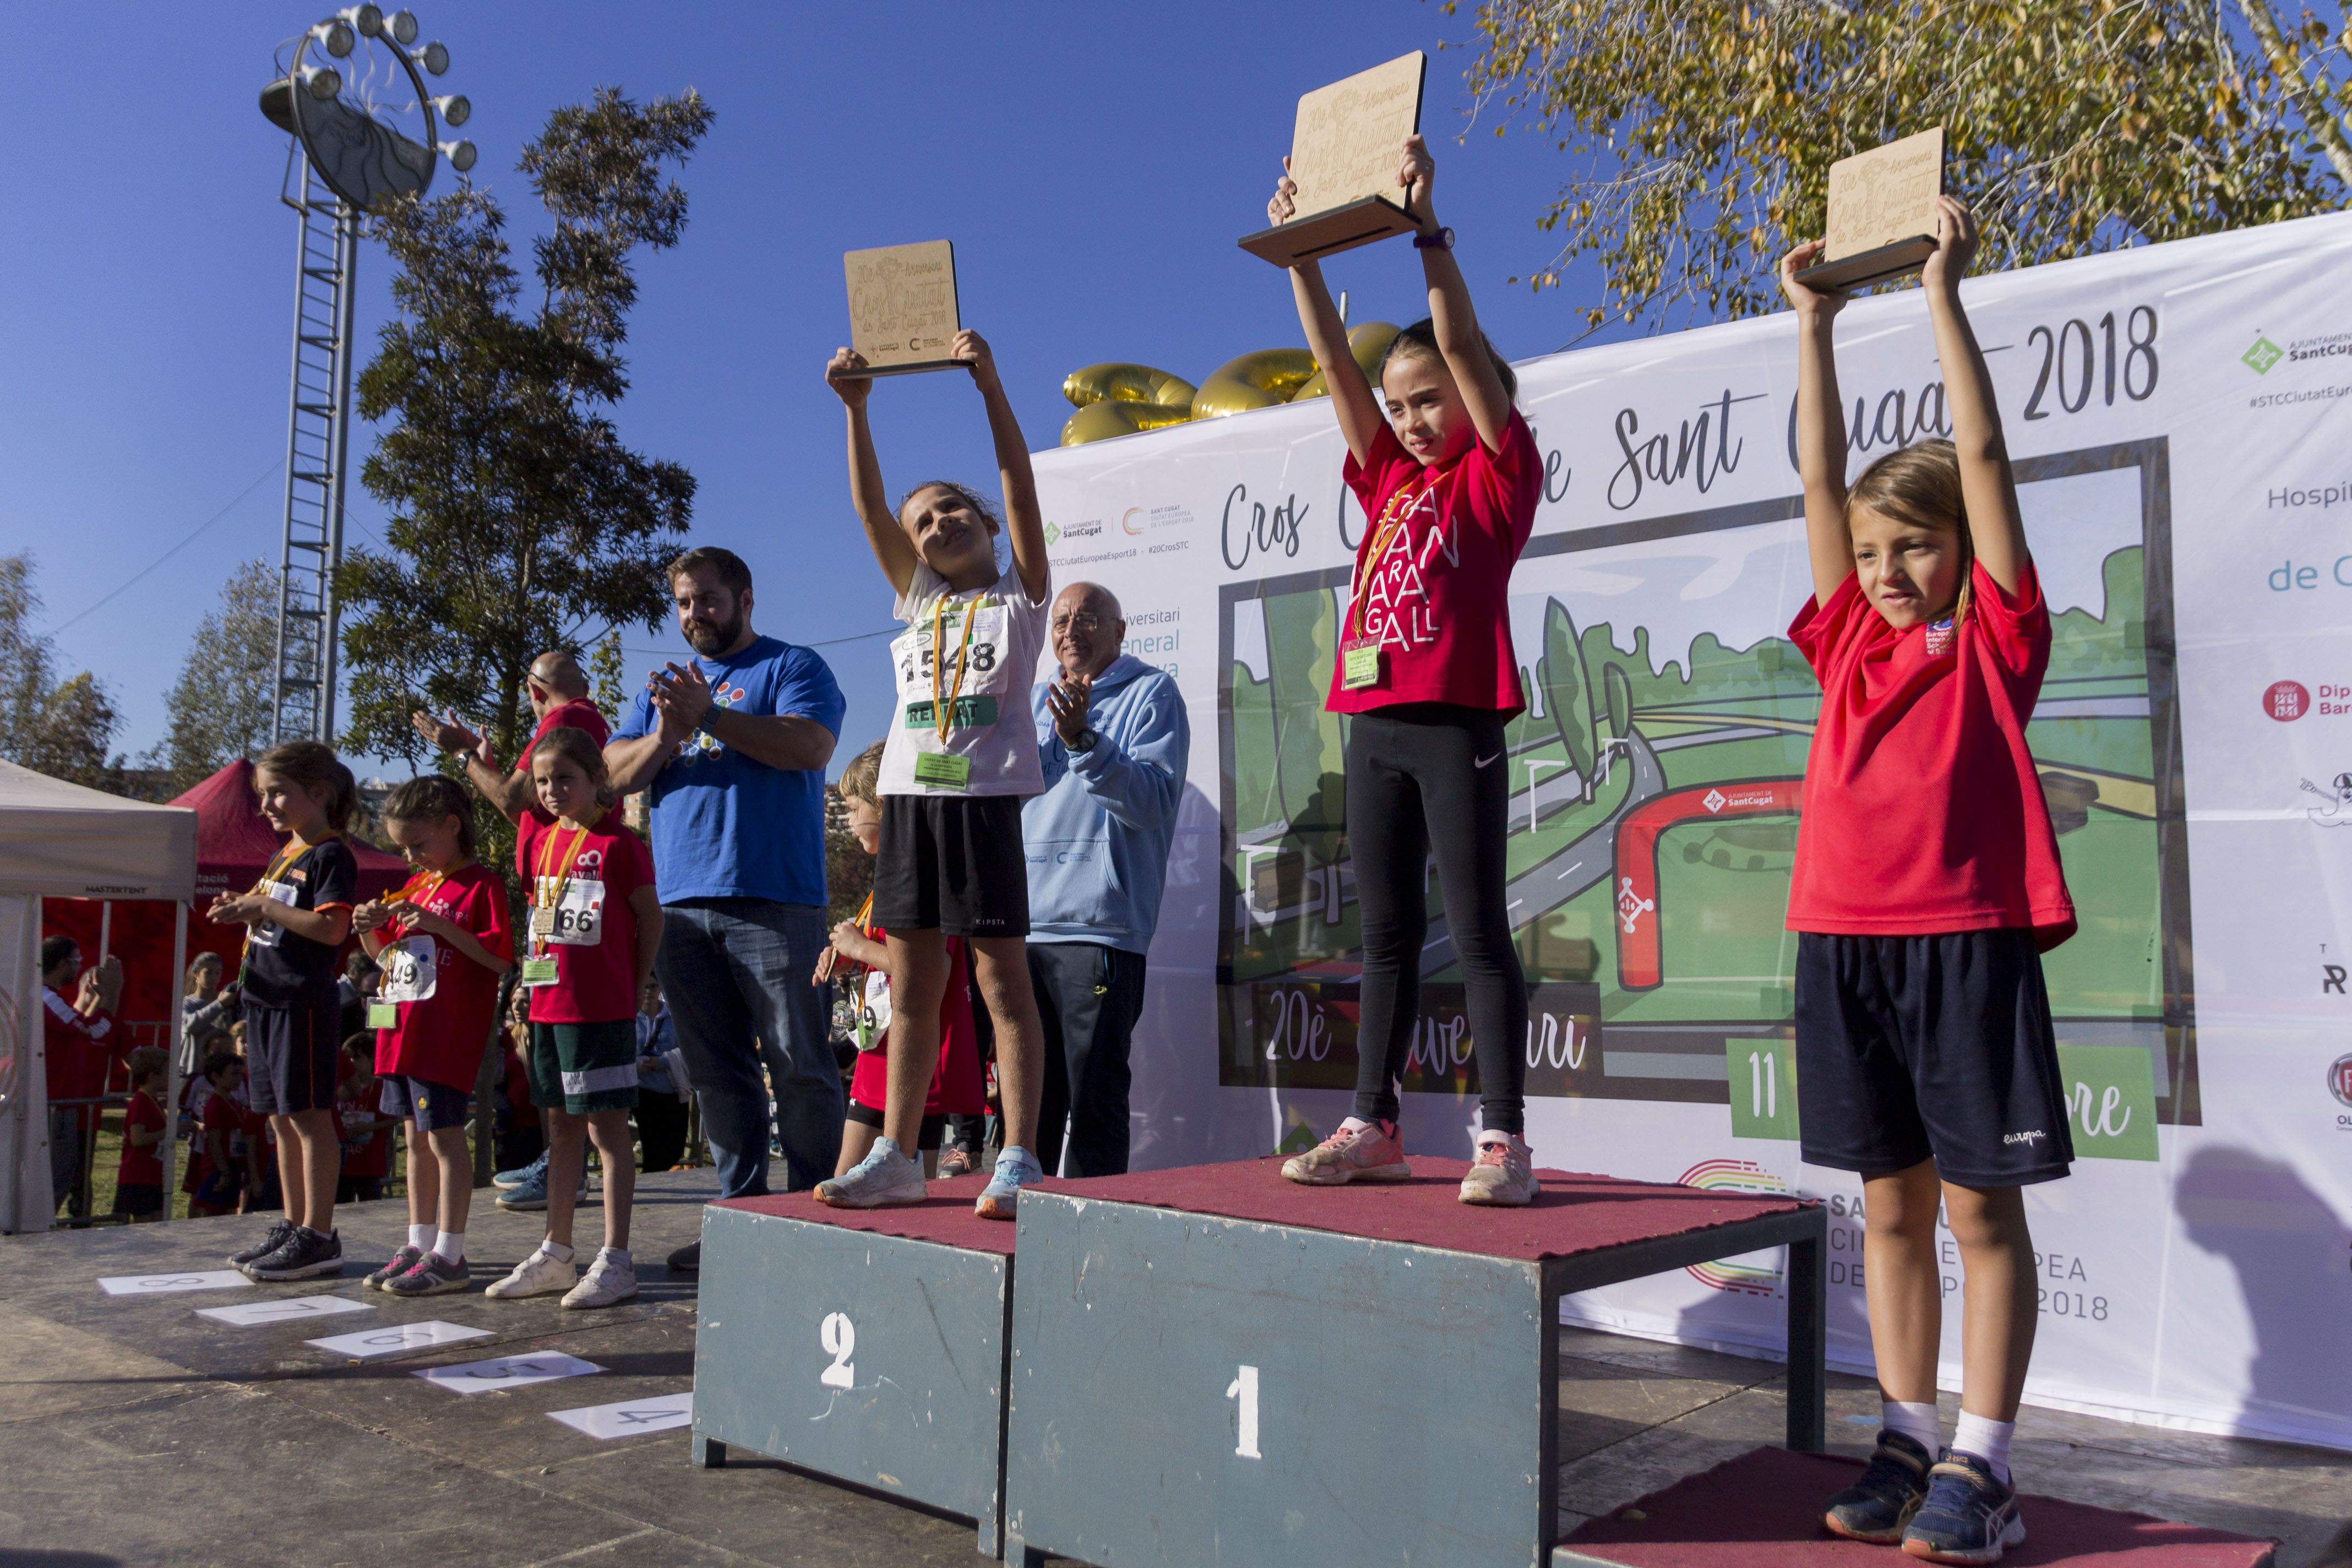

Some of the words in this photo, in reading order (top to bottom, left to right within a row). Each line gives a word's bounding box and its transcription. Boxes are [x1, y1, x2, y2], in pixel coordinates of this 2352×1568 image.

[2249, 385, 2352, 409] #STCCiutatEur
[1221, 482, 1310, 570] Cros
[1608, 389, 1768, 510] Sant
[2024, 305, 2159, 421] 2018
[1063, 520, 1095, 530] AJUNTAMENT
[1063, 526, 1102, 538] SantCugat
[1148, 540, 1189, 554] #20CrosSTC
[2268, 559, 2318, 592] de
[1125, 607, 1180, 627] iversitari
[901, 642, 996, 683] 1548
[2320, 684, 2351, 700] Dip
[2320, 703, 2352, 715] Bar
[1728, 795, 1773, 807] SantCugat
[85, 885, 148, 894] MASTERTENT
[443, 908, 469, 924] AMPA
[1266, 990, 1332, 1061] 20è
[1749, 1050, 1776, 1118] 11
[2002, 1129, 2046, 1148] europa
[1831, 1261, 1865, 1288] DE
[2037, 1288, 2109, 1321] 2018
[820, 1311, 855, 1389] 2
[616, 1408, 690, 1425] 4
[1226, 1365, 1261, 1460] 1
